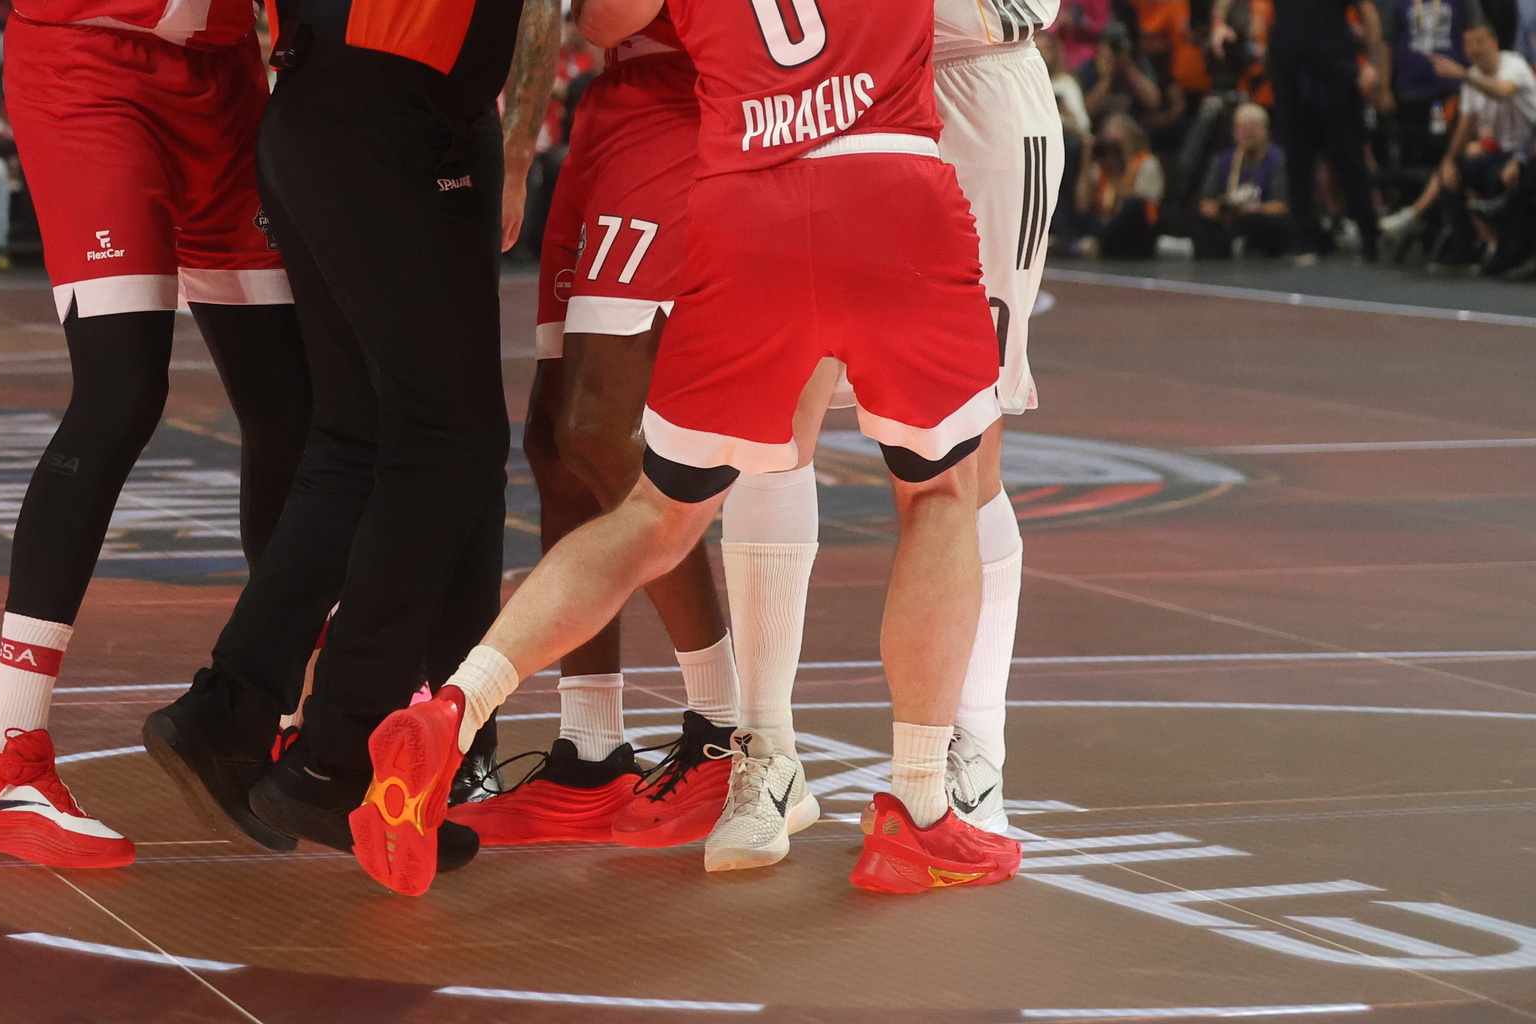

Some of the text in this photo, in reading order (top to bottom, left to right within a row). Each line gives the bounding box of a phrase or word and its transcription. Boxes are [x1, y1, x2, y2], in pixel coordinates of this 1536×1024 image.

[741, 72, 875, 151] PIRAEUS
[87, 247, 125, 261] FlexCar
[587, 214, 659, 285] 77
